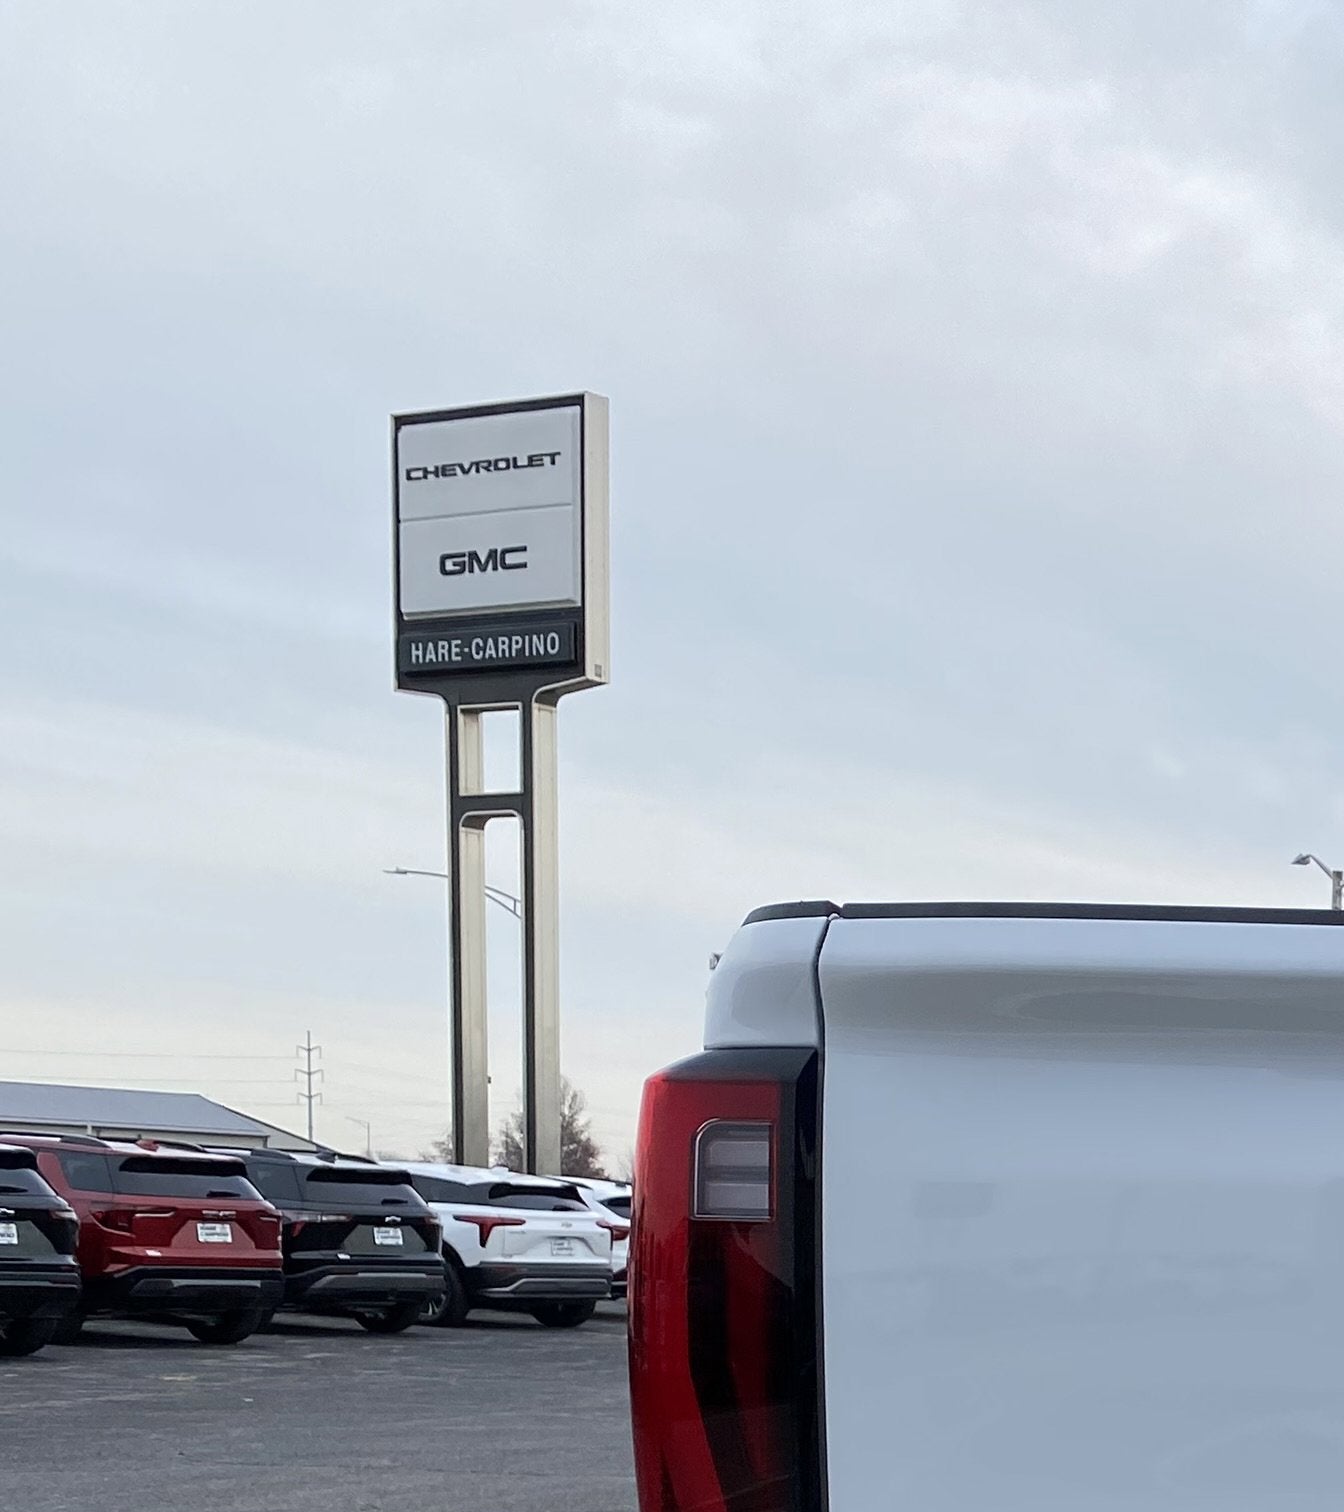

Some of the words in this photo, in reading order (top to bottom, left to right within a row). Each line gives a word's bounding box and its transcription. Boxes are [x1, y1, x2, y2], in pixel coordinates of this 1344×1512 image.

[405, 451, 561, 481] CHEVROLET
[438, 545, 528, 577] GMC
[410, 632, 560, 665] HARE-CARPINO
